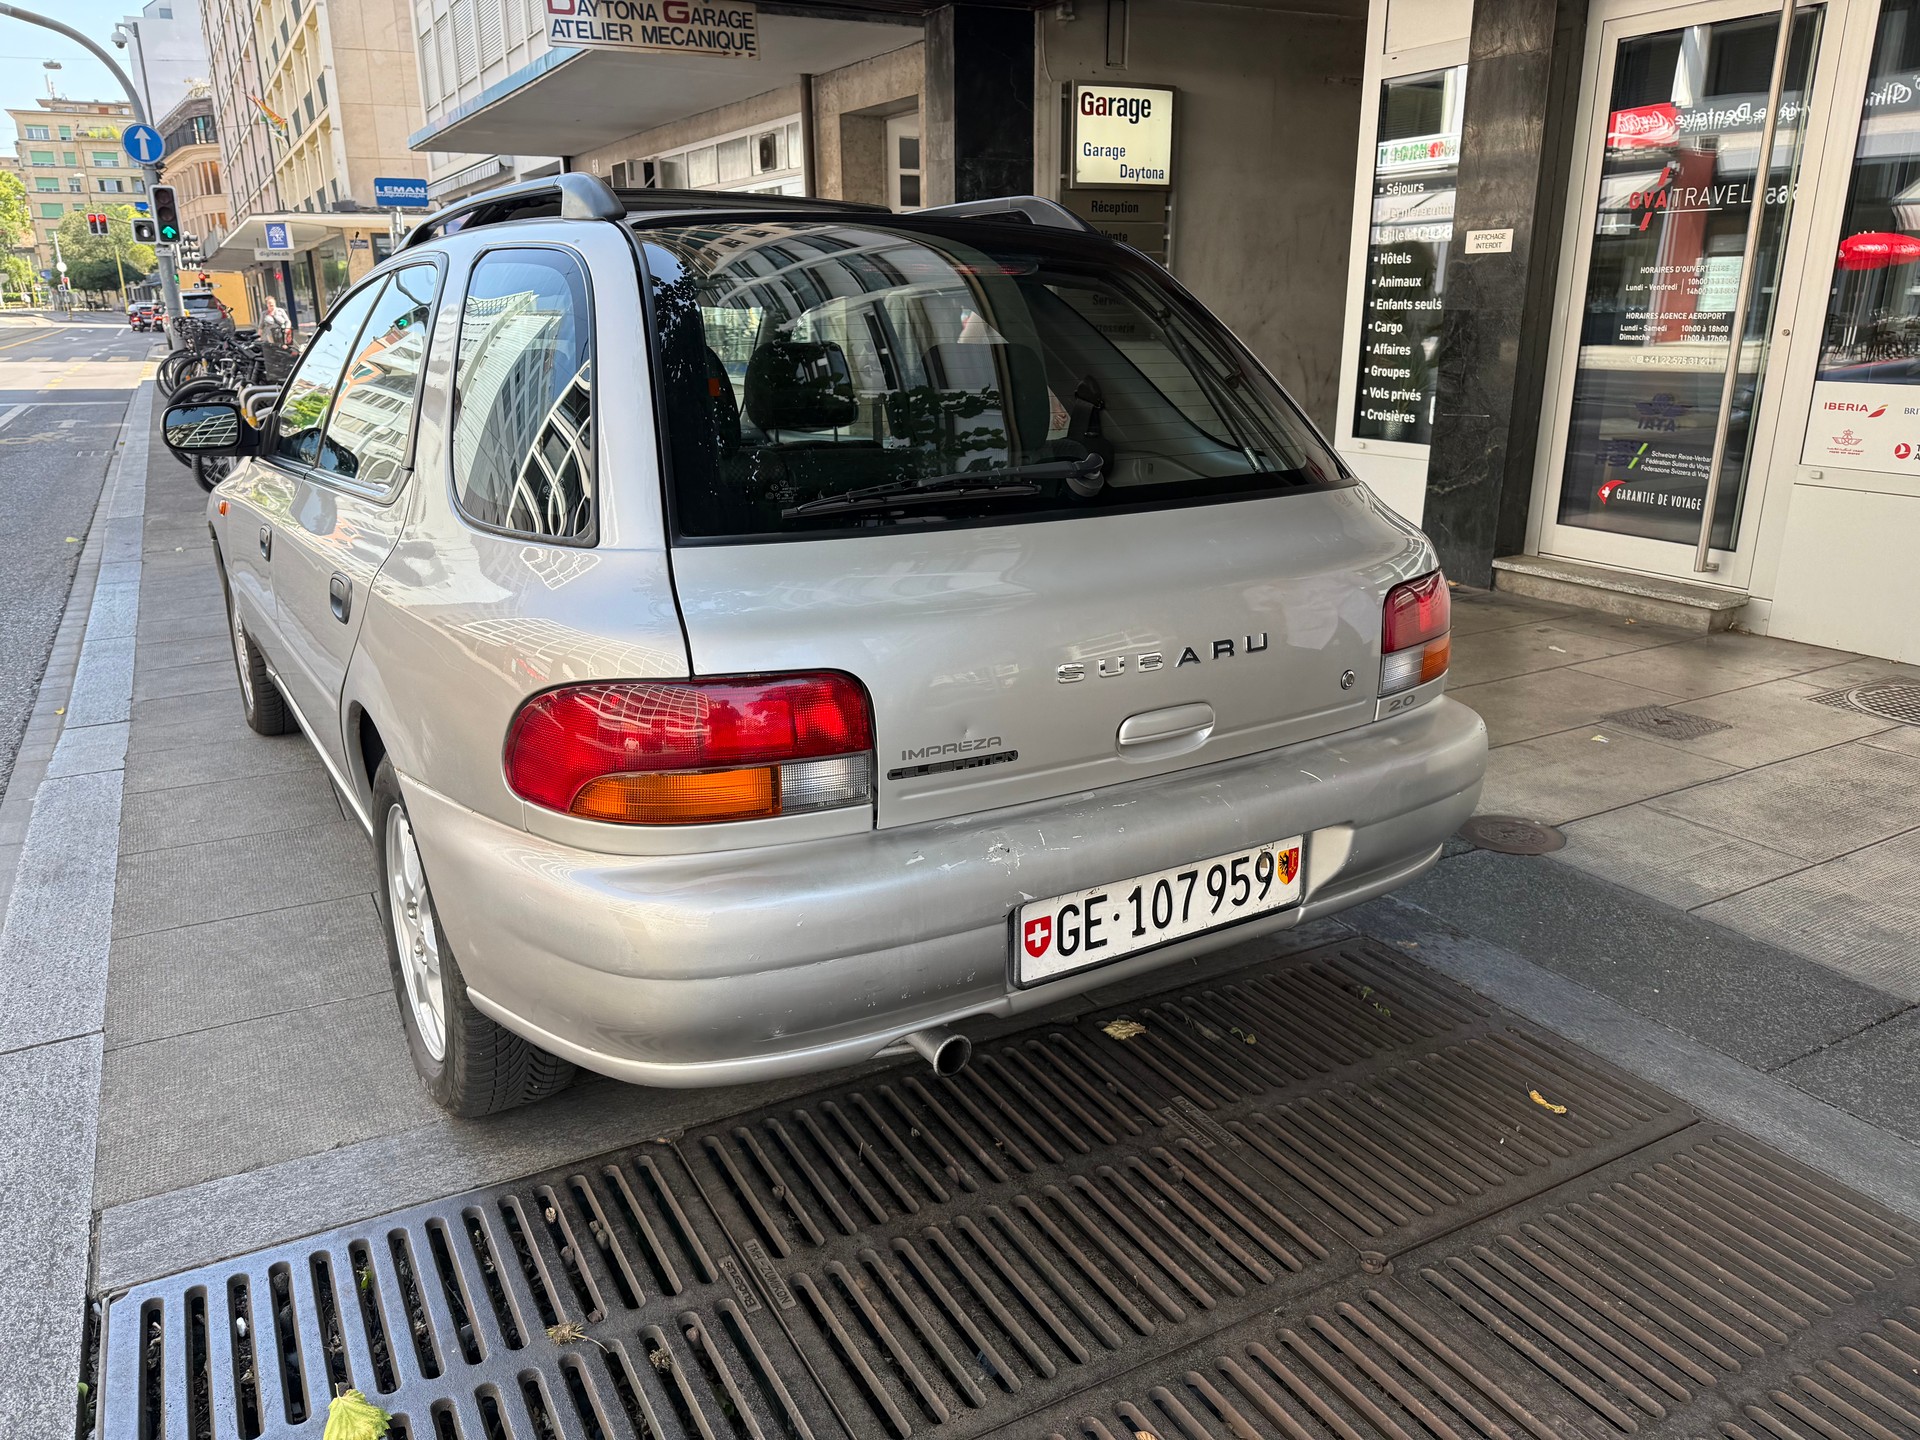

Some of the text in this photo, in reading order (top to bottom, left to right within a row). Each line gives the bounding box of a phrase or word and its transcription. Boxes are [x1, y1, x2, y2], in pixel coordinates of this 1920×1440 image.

[548, 0, 754, 29] DAYTONA GARAGE
[551, 19, 757, 50] ATELIER MECANIQUE
[1080, 91, 1151, 124] Garage
[1083, 142, 1126, 160] Garage
[1120, 164, 1164, 181] Daytona
[375, 186, 425, 194] LEMAN
[1386, 182, 1424, 196] Séjours
[1629, 184, 1752, 209] GVA TRAVEL
[1091, 200, 1139, 215] Réception
[1474, 233, 1506, 241] AFFICHAGE
[1380, 252, 1412, 264] Hôtels
[1640, 266, 1674, 274] HORAIRES
[1378, 275, 1422, 287] Animaux
[1649, 283, 1678, 291] Vendredi
[1376, 297, 1442, 310] Enfants seuls
[1625, 312, 1727, 320] HORAIRES AGENCE AEROPORT
[1374, 321, 1403, 335] Cargo
[1620, 324, 1638, 332] Lundi
[1643, 324, 1668, 332] Samedi
[1619, 333, 1650, 341] Dimanche
[1373, 343, 1411, 355] Affaires
[1371, 365, 1411, 380] Groupes
[1369, 386, 1422, 402] Vols privés
[1824, 402, 1868, 412] IBERIA
[1367, 408, 1416, 423] Croisières
[1616, 488, 1702, 511] GARANTIE DE VOYAGE
[1056, 632, 1269, 684] SUBARU
[1388, 694, 1416, 712] 2.0
[901, 736, 1002, 761] IMPREZA
